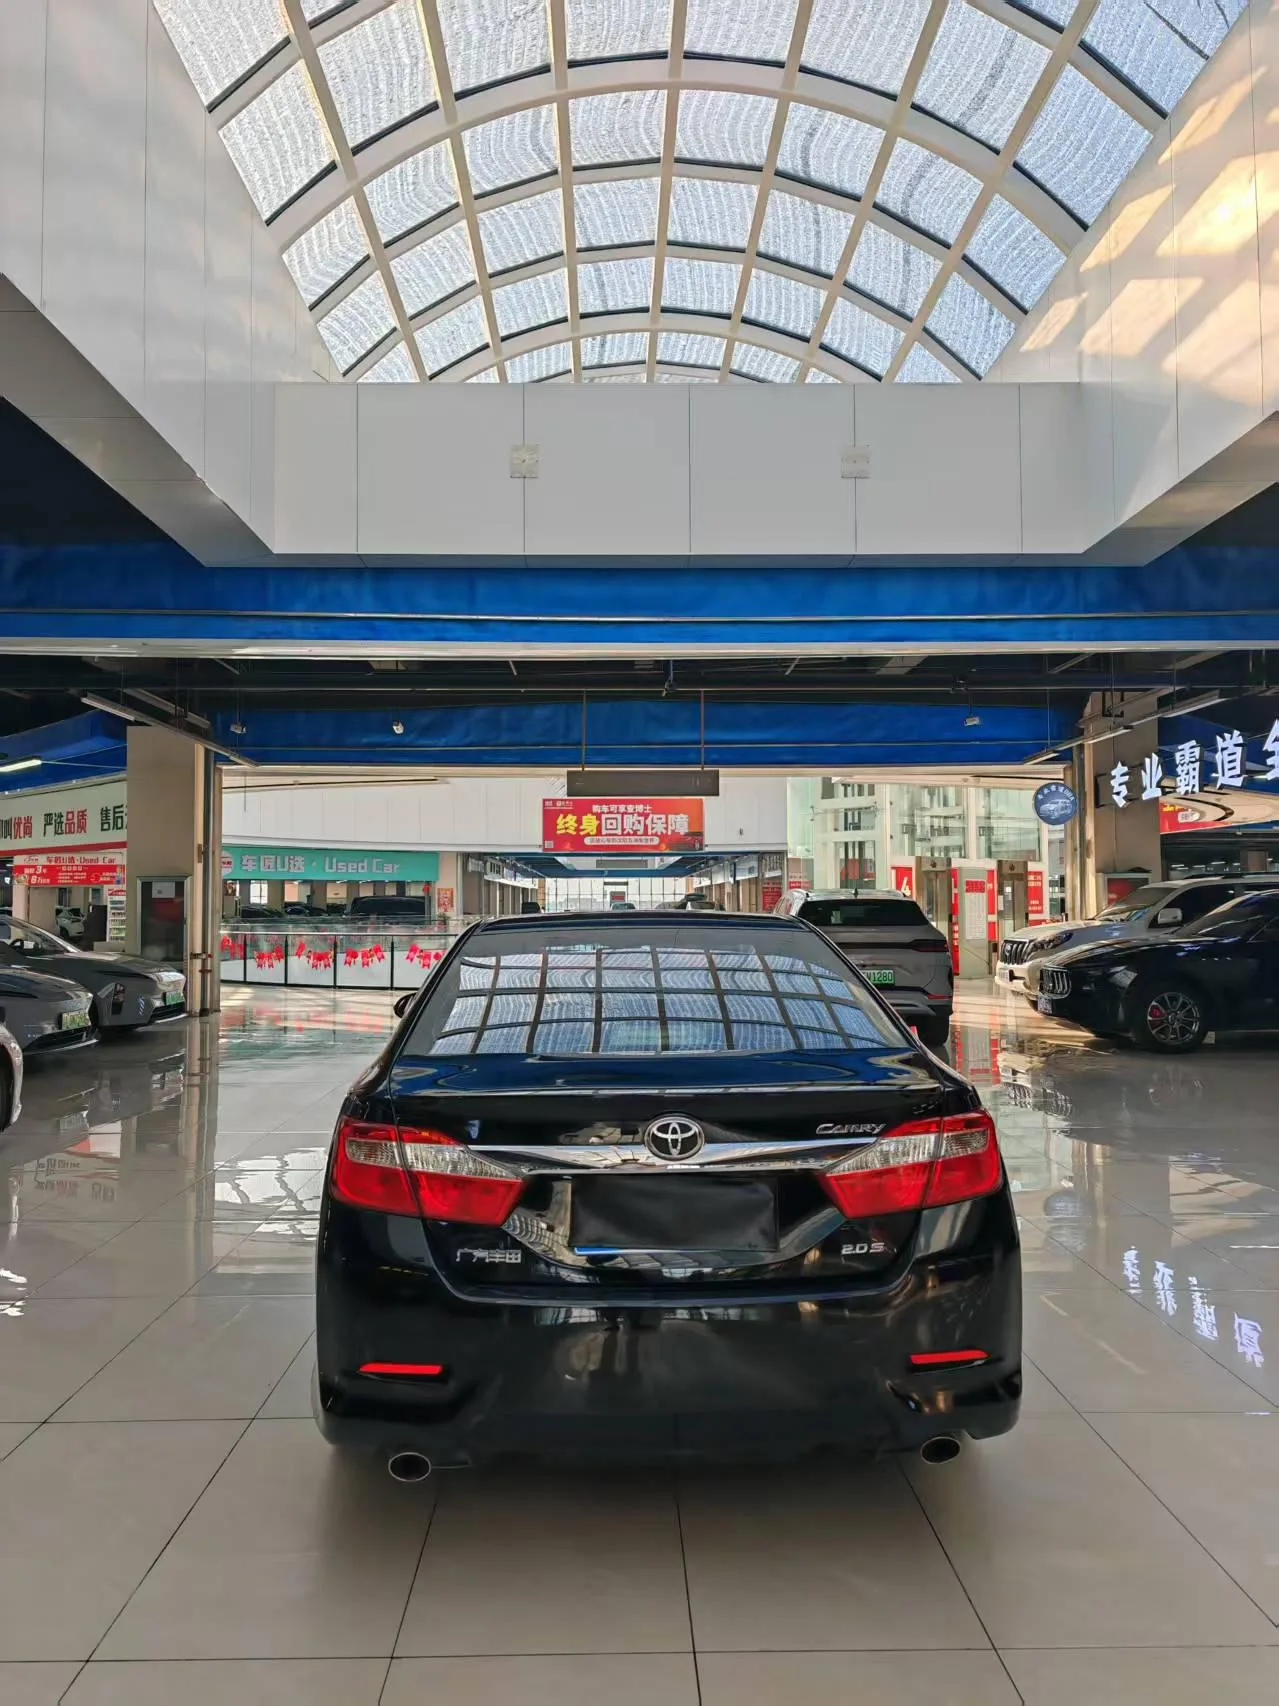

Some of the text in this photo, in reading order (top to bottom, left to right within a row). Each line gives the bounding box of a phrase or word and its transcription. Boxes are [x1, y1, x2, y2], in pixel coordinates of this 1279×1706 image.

[0, 803, 127, 840] 叫优尚 严选品质 售后
[556, 814, 689, 835] 终身回购保障
[324, 856, 368, 873] Used
[372, 857, 400, 873] Car
